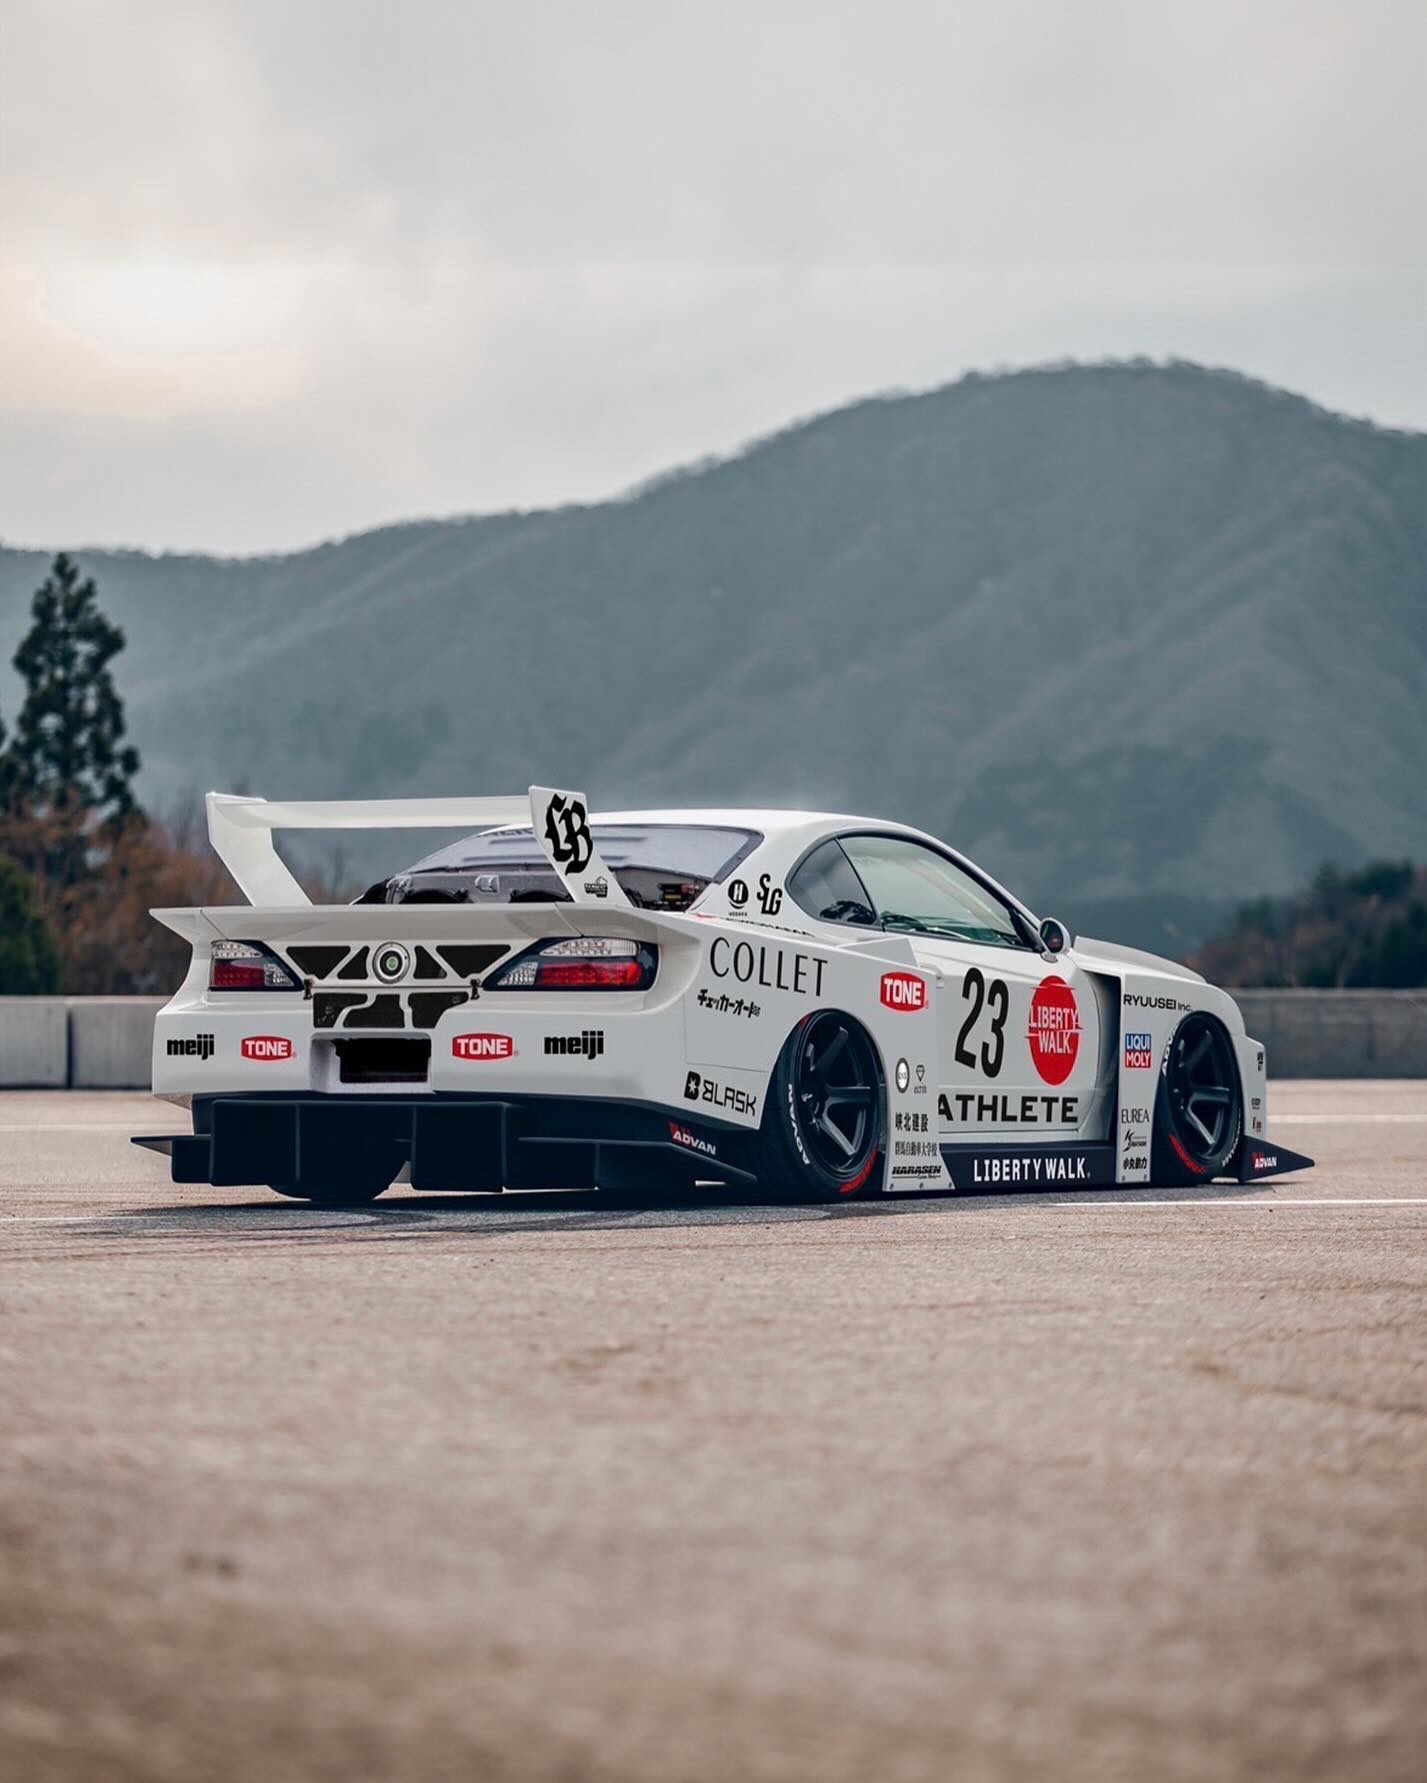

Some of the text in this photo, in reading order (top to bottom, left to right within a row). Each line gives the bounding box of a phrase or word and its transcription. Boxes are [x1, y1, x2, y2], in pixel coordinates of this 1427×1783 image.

[710, 936, 828, 997] COLLET
[884, 978, 922, 1006] TONE
[1123, 994, 1176, 1010] RYUUSEI
[954, 967, 1009, 1078] 23
[1029, 1006, 1078, 1031] LIBERTY
[167, 1034, 215, 1060] meiji
[245, 1040, 288, 1057] TONE
[456, 1038, 509, 1055] TONE
[544, 1031, 604, 1060] meiji
[1039, 1030, 1070, 1054] WALK
[1126, 1034, 1151, 1050] LIQUI
[1126, 1052, 1151, 1067] MOLY
[938, 1093, 1079, 1123] ATHLETE
[1121, 1108, 1149, 1124] EUREA
[673, 1130, 717, 1156] ADVAN
[974, 1157, 1086, 1182] LIBERTY WALK
[1254, 1157, 1277, 1169] ADVAN
